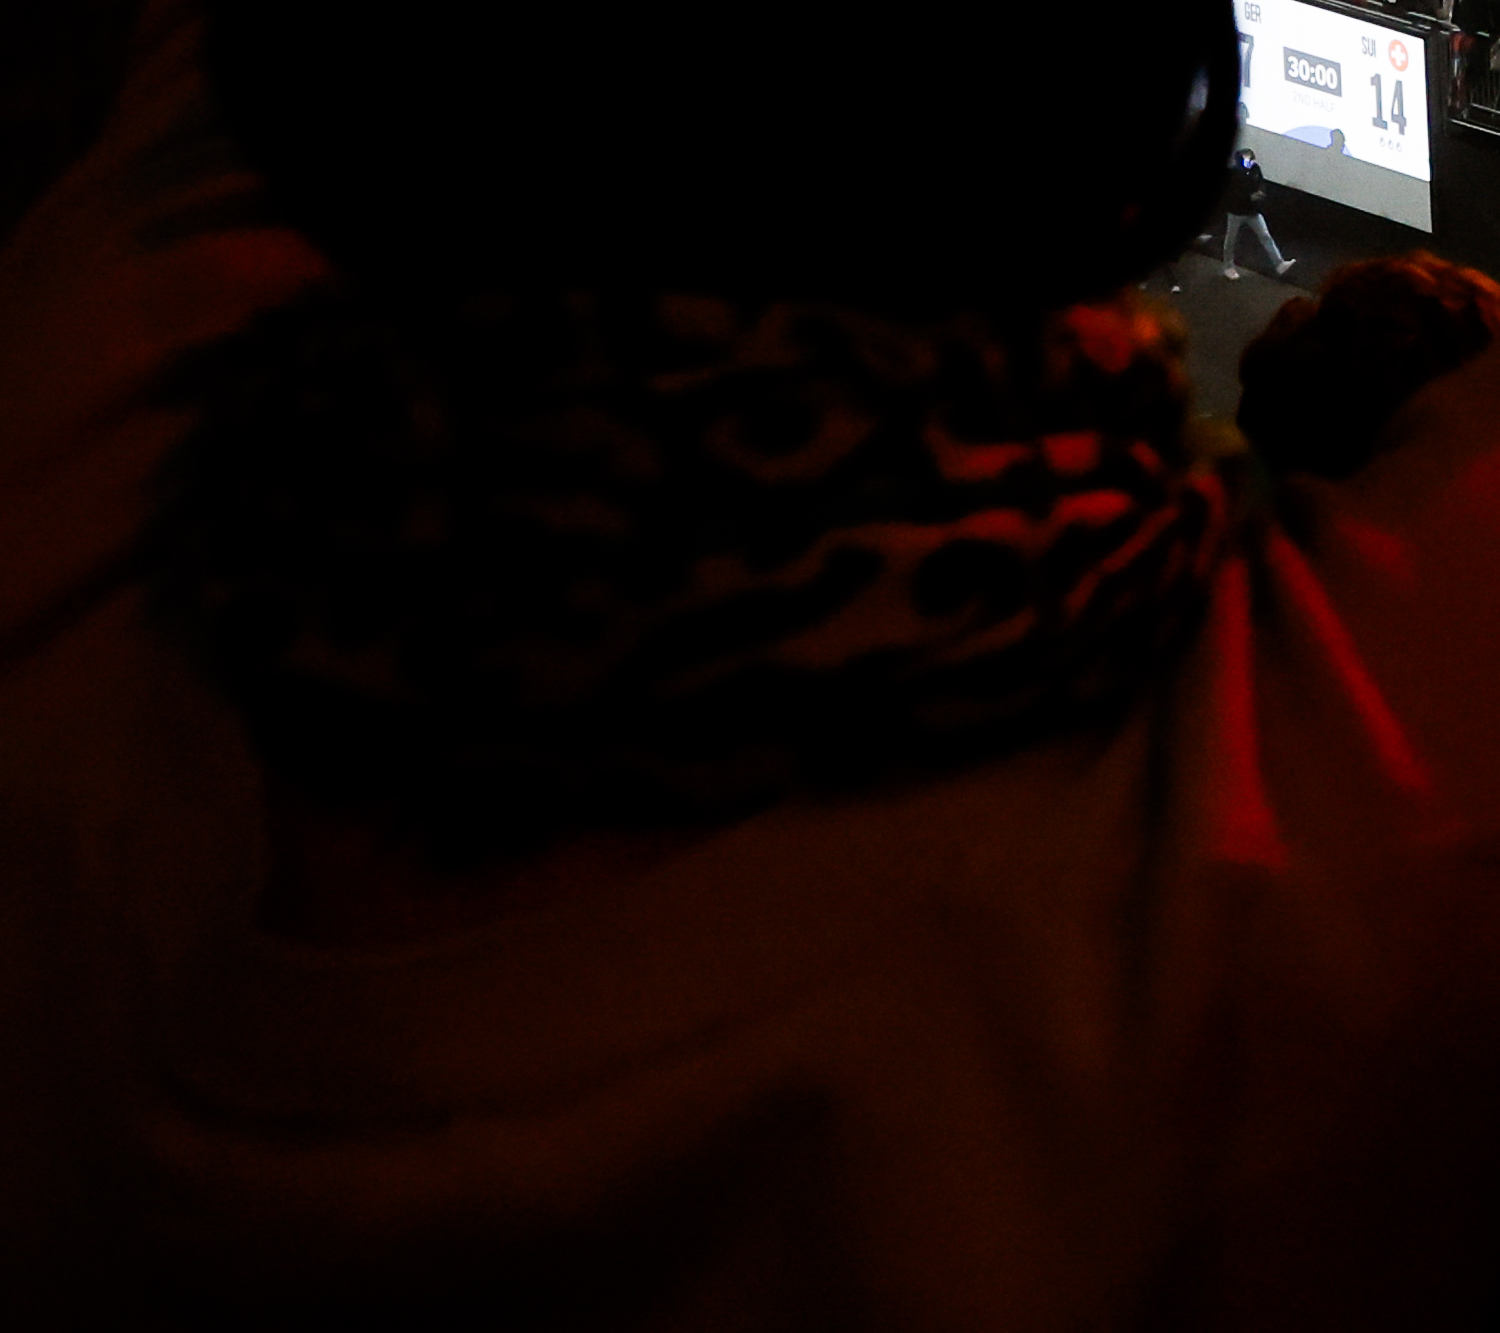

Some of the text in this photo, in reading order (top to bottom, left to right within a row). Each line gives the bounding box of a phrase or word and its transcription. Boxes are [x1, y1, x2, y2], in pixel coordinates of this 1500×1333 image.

[1244, 1, 1377, 58] GER SUI
[1240, 33, 1407, 136] 7 30:00 14
[1292, 90, 1336, 113] 2ND HALF
